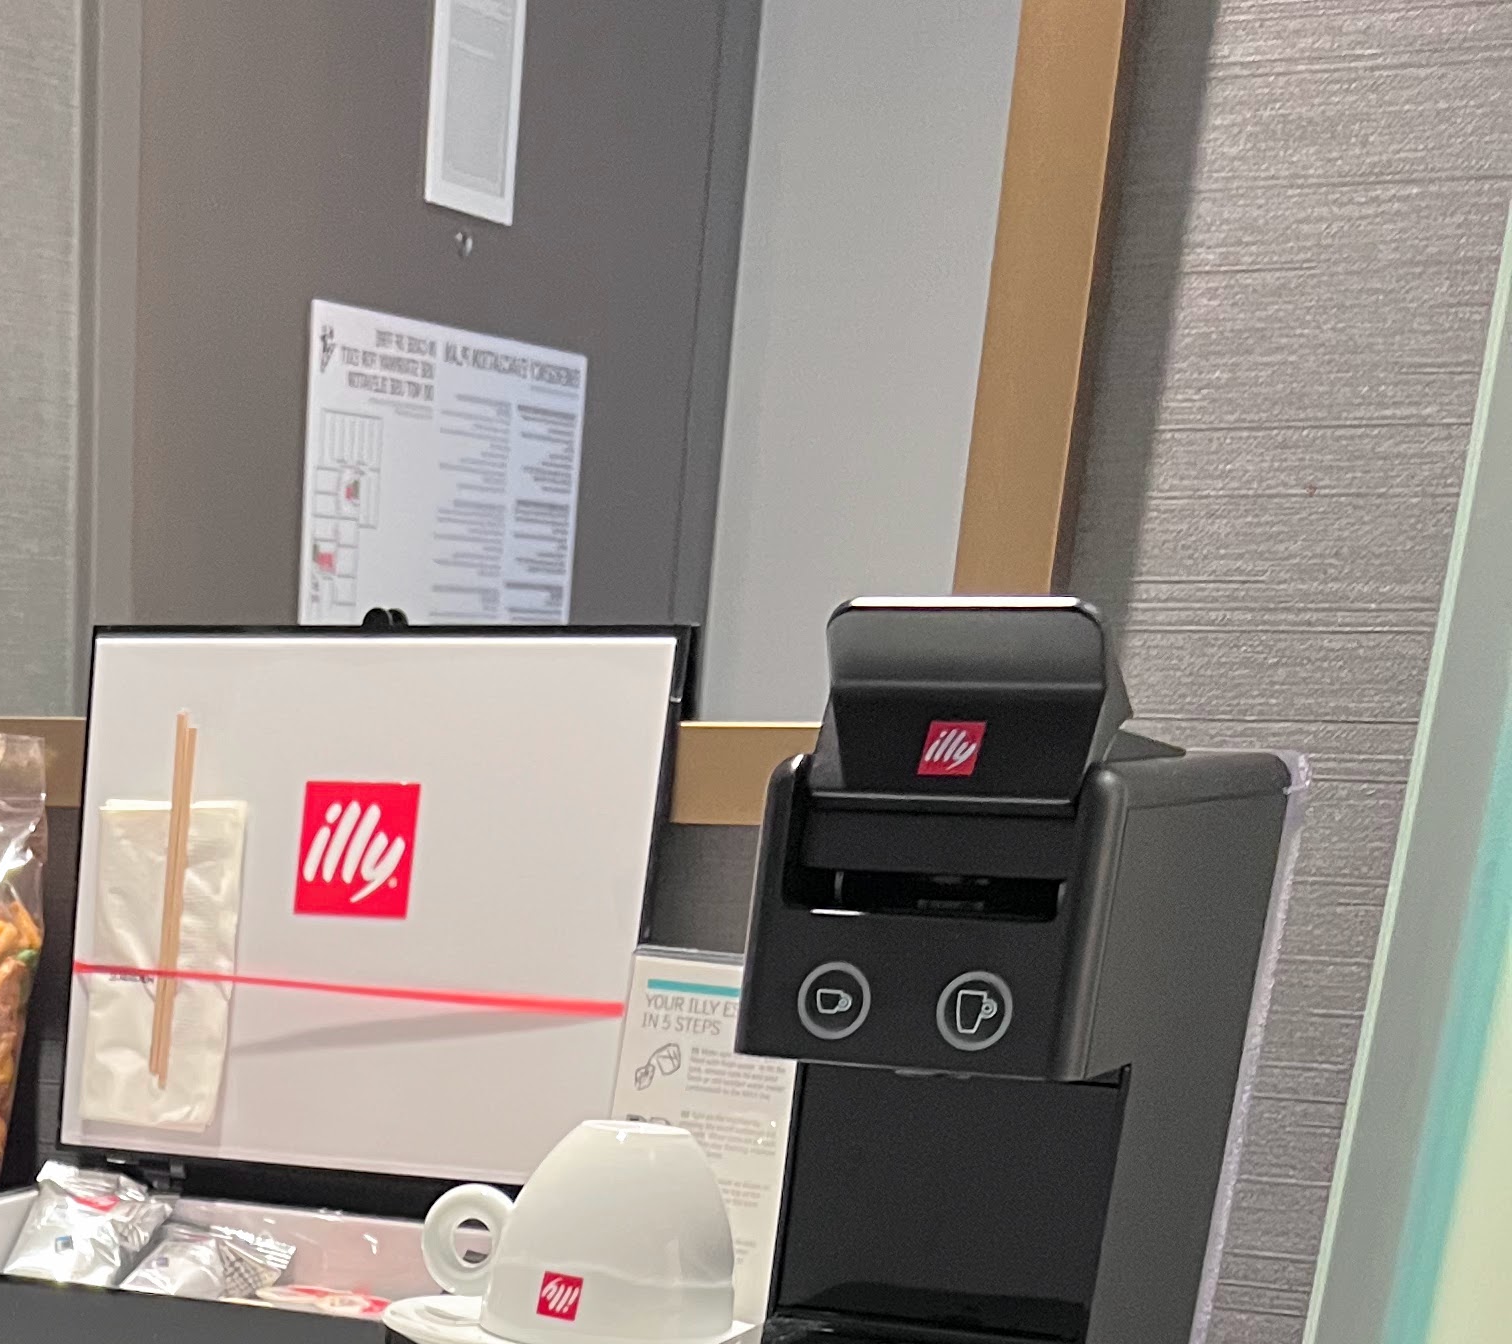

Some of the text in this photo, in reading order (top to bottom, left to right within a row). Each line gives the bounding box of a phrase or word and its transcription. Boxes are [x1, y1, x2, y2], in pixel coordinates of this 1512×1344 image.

[924, 729, 977, 771] illy
[302, 800, 406, 902] illy
[646, 993, 685, 1011] YOUR
[688, 997, 720, 1015] ILLY
[642, 1012, 723, 1035] IN 5 STEPS
[542, 1277, 580, 1313] illy
